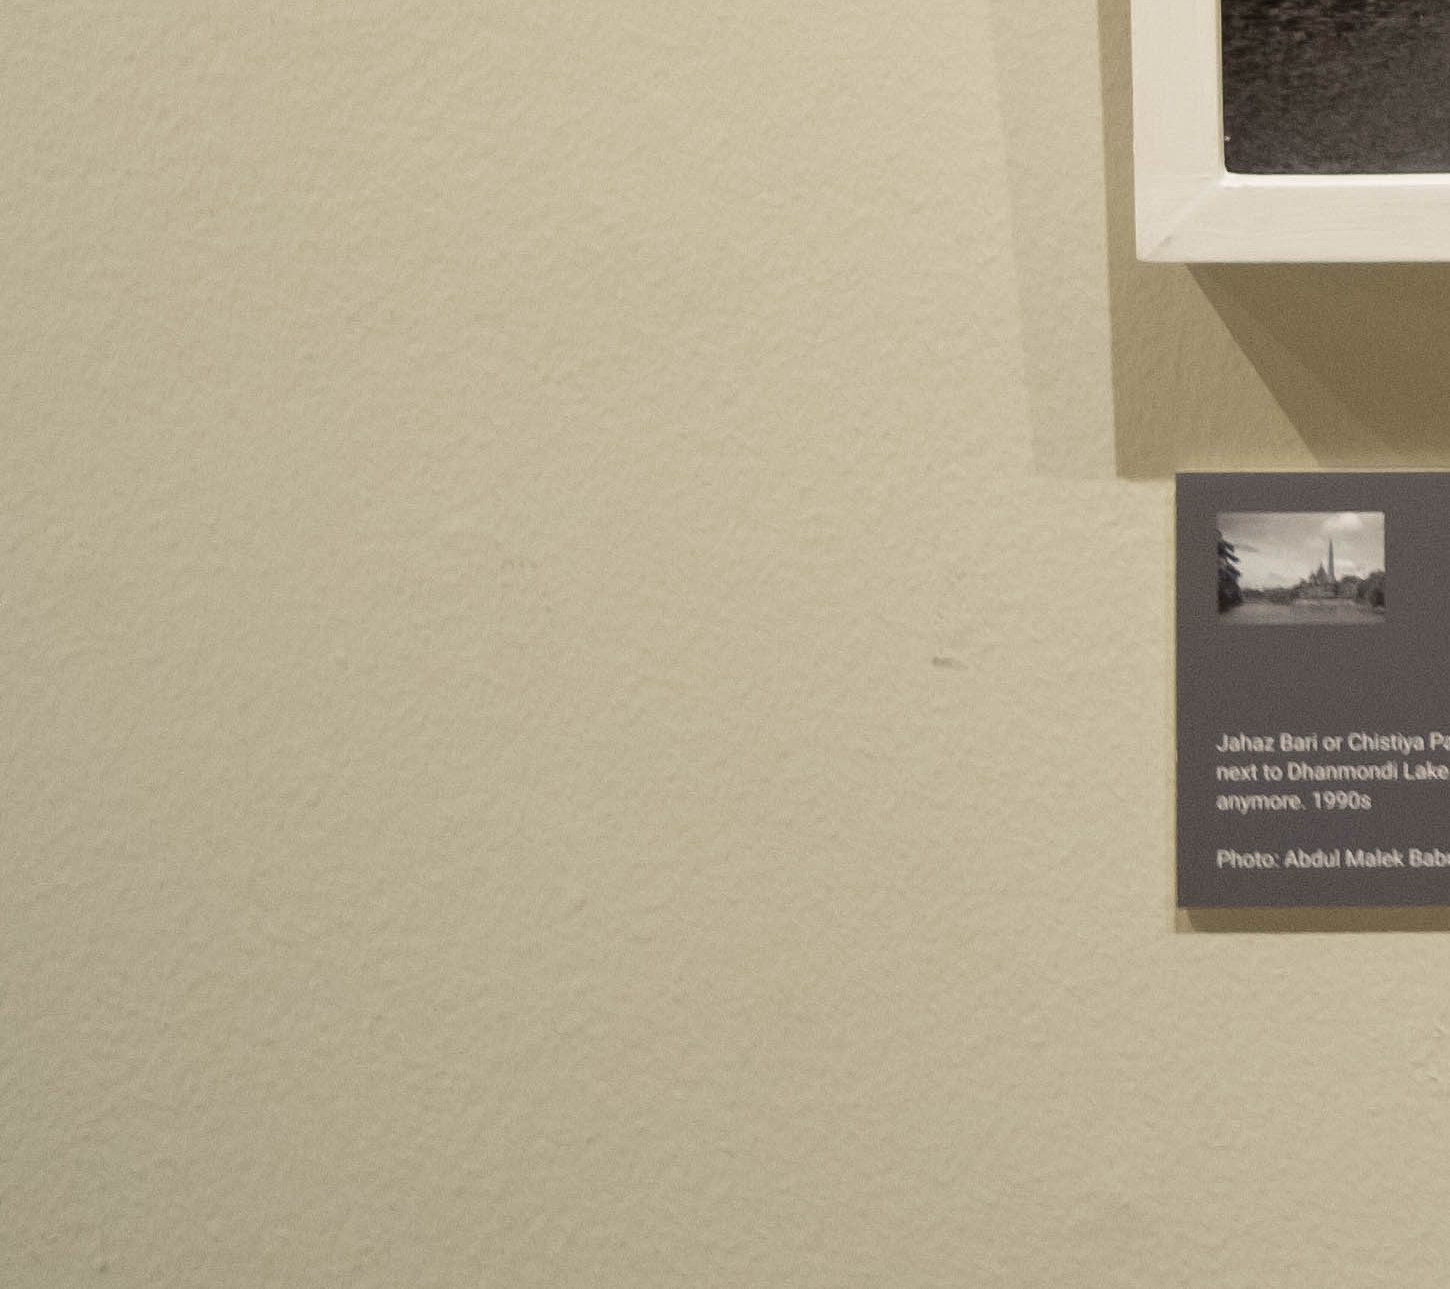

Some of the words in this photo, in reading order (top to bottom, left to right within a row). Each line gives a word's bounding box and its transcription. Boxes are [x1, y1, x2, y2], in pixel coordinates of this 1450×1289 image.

[1216, 732, 1275, 753] Jahaz
[1279, 732, 1318, 752] Bari
[1322, 736, 1344, 752] or
[1347, 732, 1425, 755] Chistiya
[1216, 763, 1258, 782] next
[1262, 764, 1284, 781] to
[1287, 761, 1399, 781] Dhanmondi
[1312, 790, 1372, 810] 1990s
[1216, 849, 1279, 869] Photo:
[1284, 849, 1341, 868] Abdul
[1345, 848, 1405, 868] Malek
